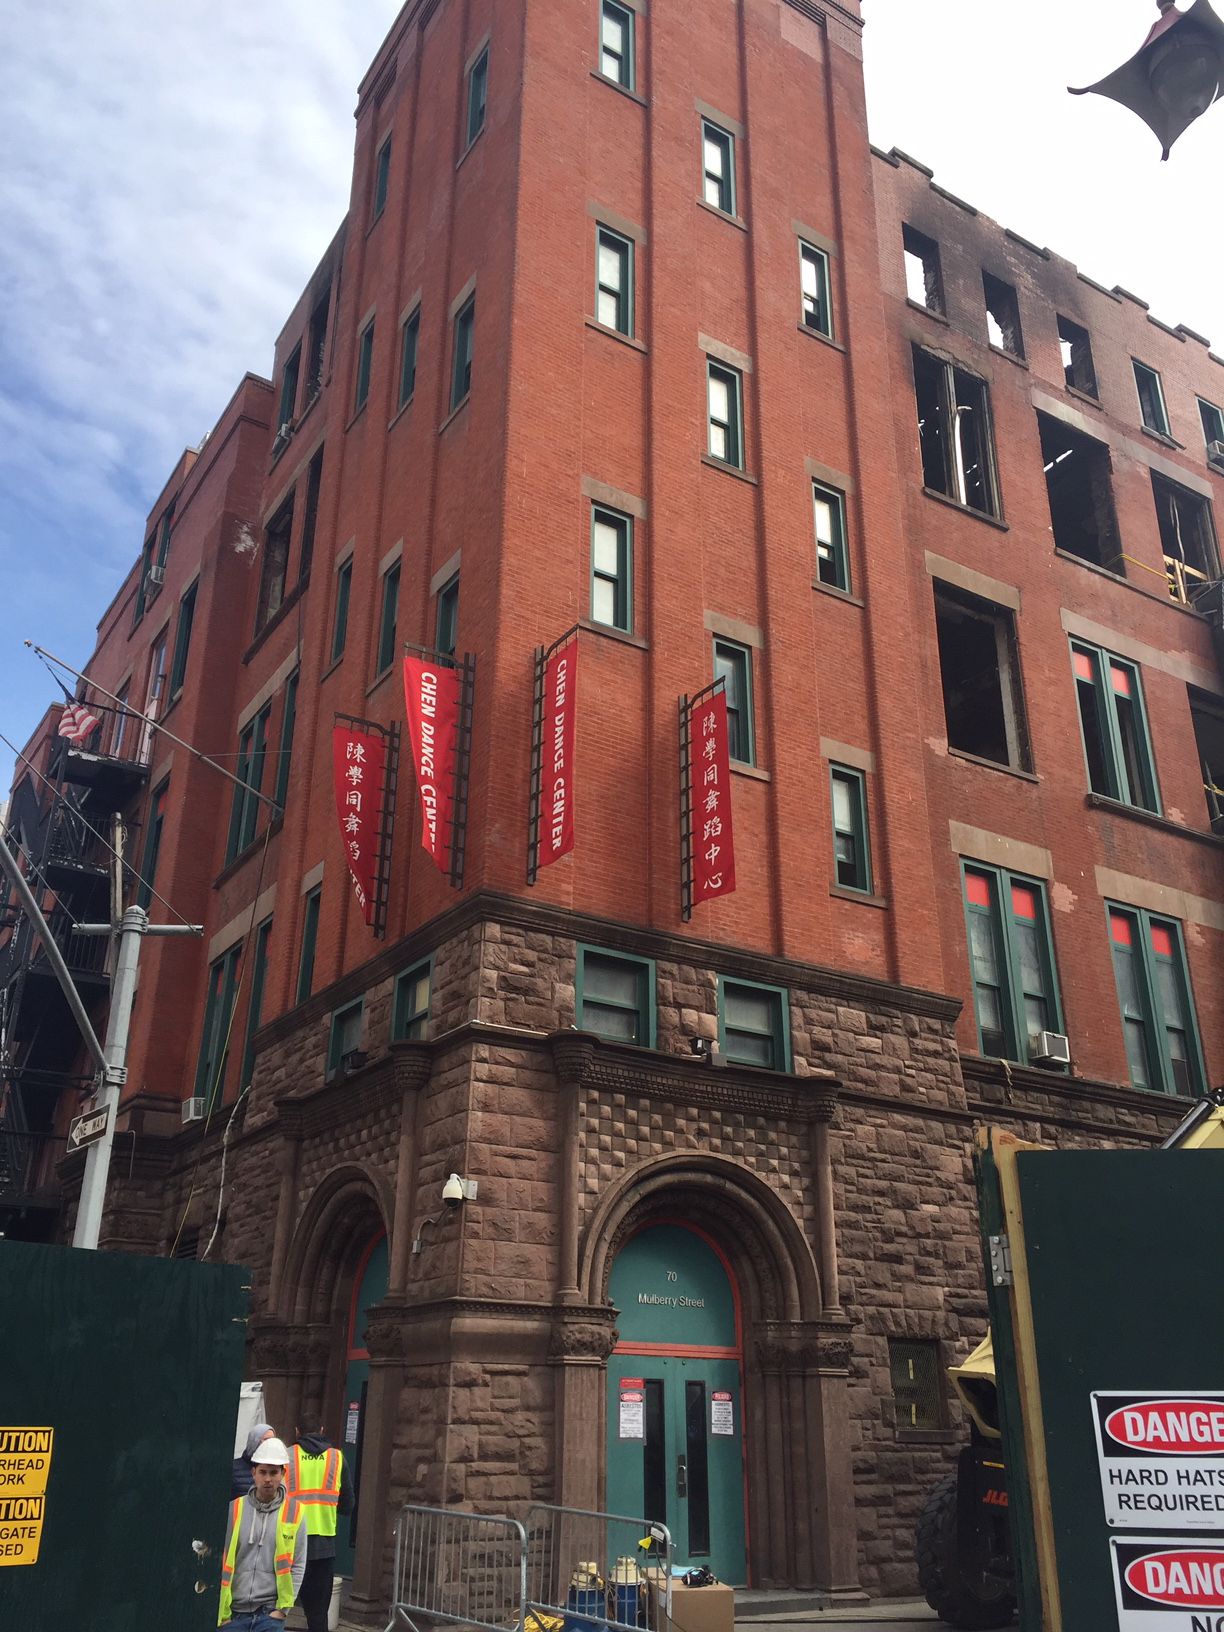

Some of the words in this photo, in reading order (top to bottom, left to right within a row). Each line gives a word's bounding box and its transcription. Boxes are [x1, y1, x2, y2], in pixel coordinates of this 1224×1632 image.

[420, 671, 438, 718] CHEN
[555, 659, 567, 708] CHEN
[420, 722, 435, 780] DANCE
[553, 711, 565, 773] DANCE
[420, 783, 437, 854] CENT
[552, 777, 566, 851] CENTER
[702, 711, 723, 889] 陳學同舞蹈中心
[638, 1292, 678, 1308] Mulberry
[679, 1295, 705, 1308] Street
[666, 1270, 678, 1282] 70
[1108, 1469, 1169, 1486] HARD
[0, 1526, 37, 1540] GATE
